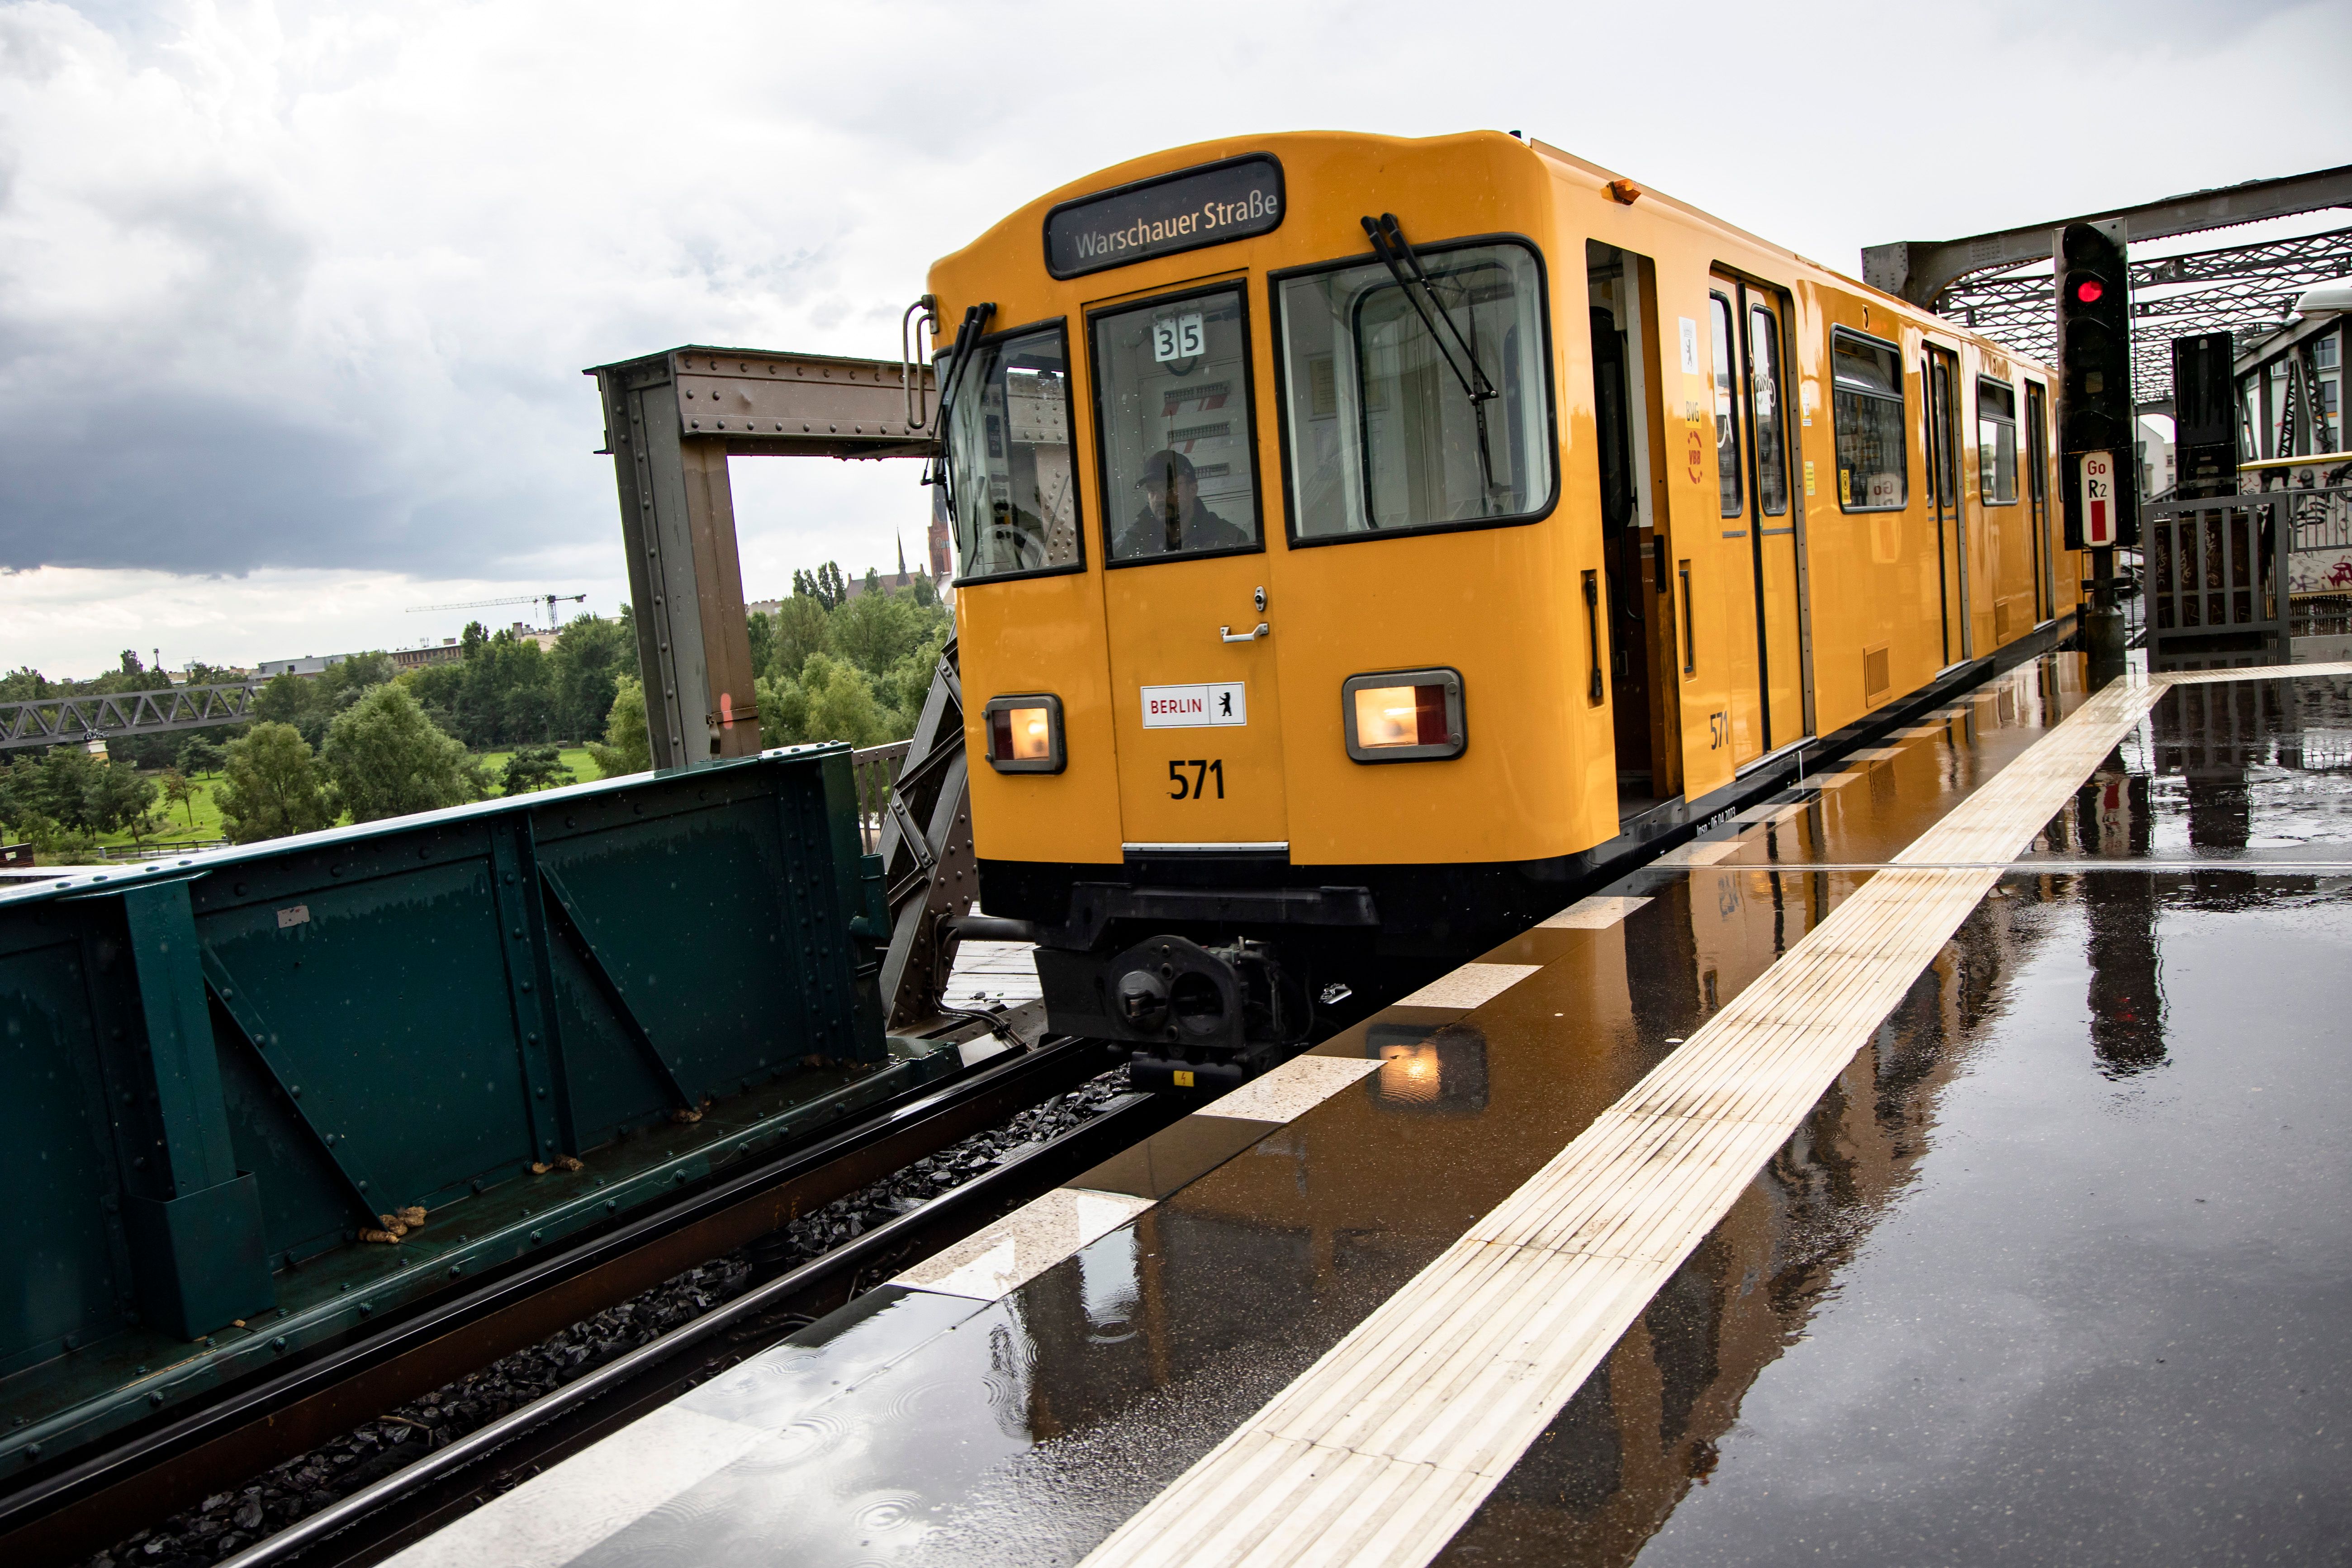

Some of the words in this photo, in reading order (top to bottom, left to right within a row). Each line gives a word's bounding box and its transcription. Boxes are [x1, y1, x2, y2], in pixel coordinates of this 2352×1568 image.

[1075, 213, 1200, 258] Warschauer
[1204, 189, 1277, 229] Straße
[1159, 325, 1199, 356] 35
[1686, 401, 1699, 422] BVG
[1688, 450, 1701, 465] VBB
[2087, 460, 2106, 475] Go
[2088, 479, 2107, 498] R2
[1150, 698, 1202, 714] BERLIN
[1710, 711, 1729, 750] 571
[1168, 759, 1224, 800] 571
[1711, 806, 1736, 829] 06042023
